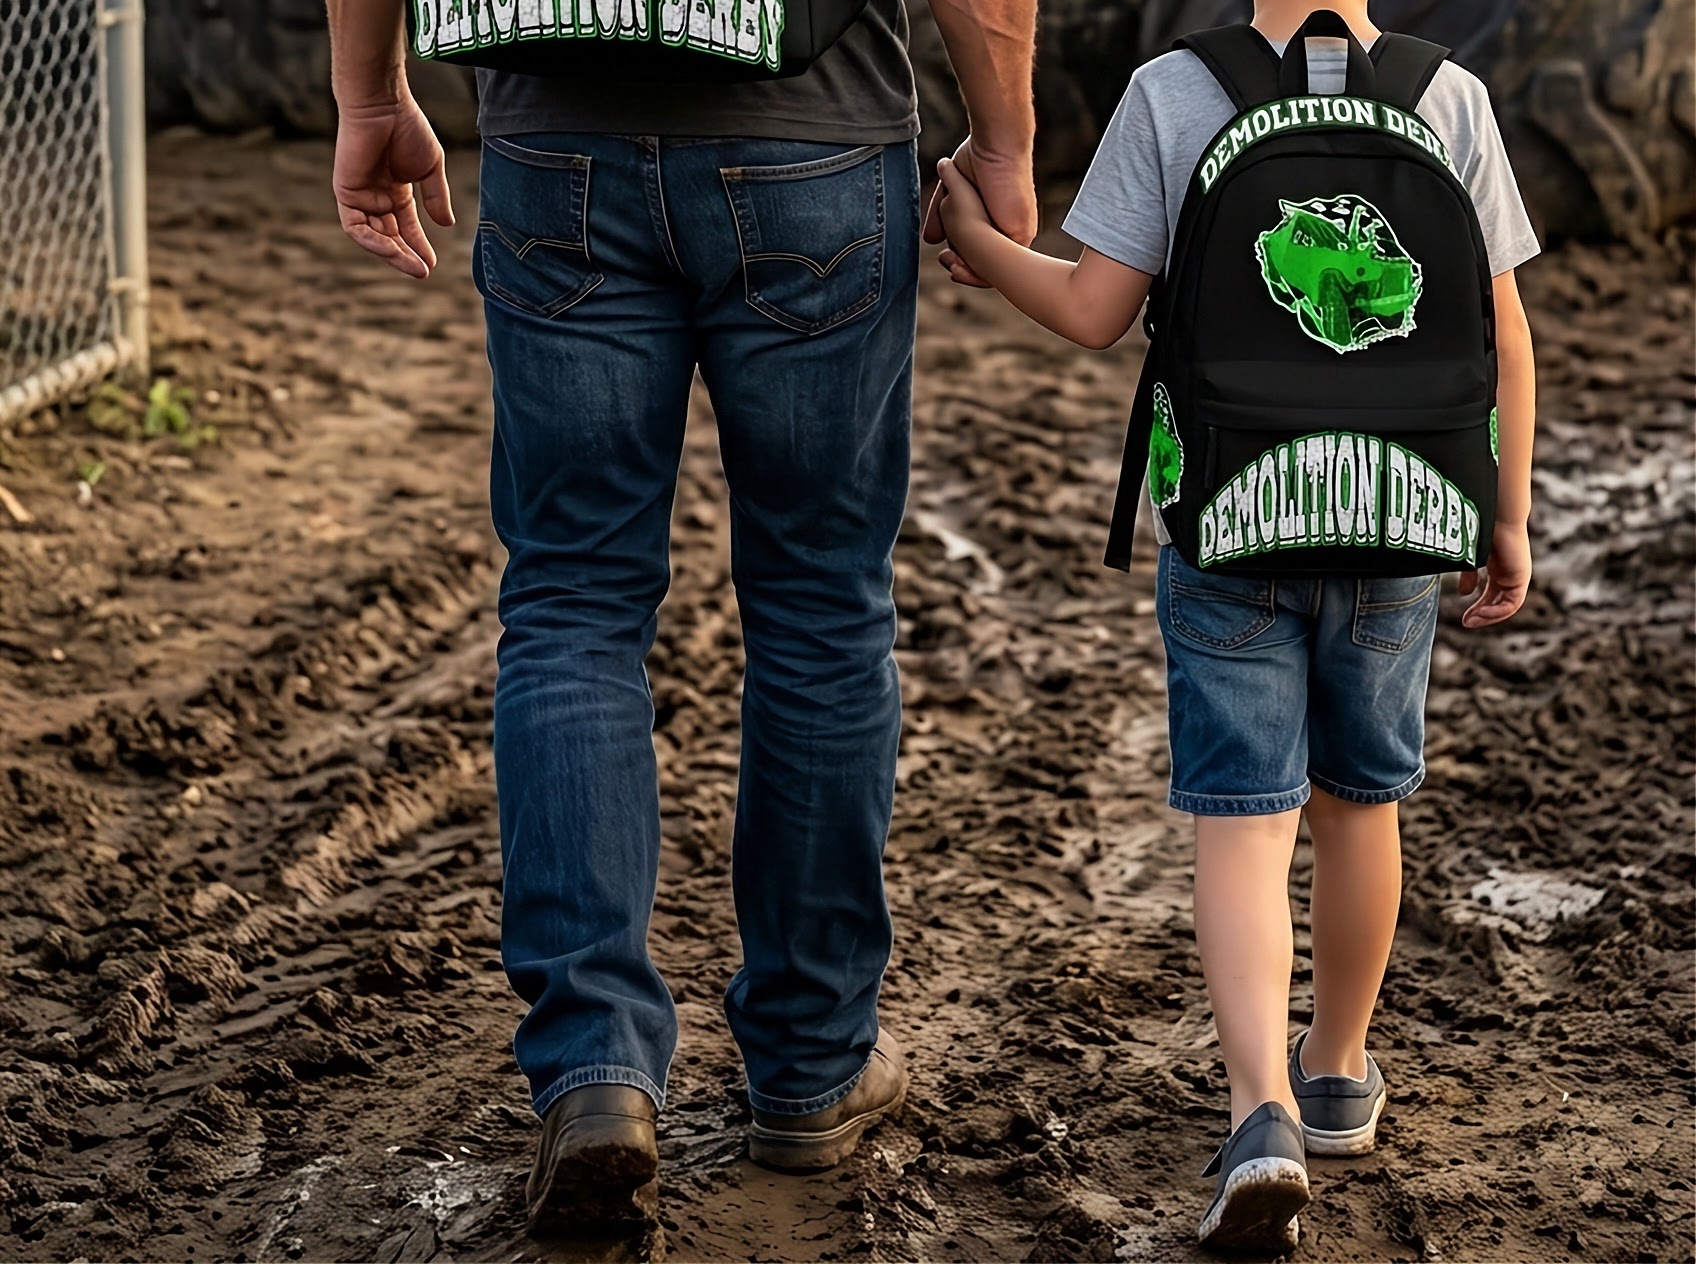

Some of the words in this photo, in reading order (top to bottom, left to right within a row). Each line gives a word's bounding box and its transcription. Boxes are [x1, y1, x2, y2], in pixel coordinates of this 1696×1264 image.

[1200, 97, 1377, 192] DEMOLITION
[1199, 431, 1382, 567] DEMOLITION
[1386, 442, 1479, 567] DERBY
